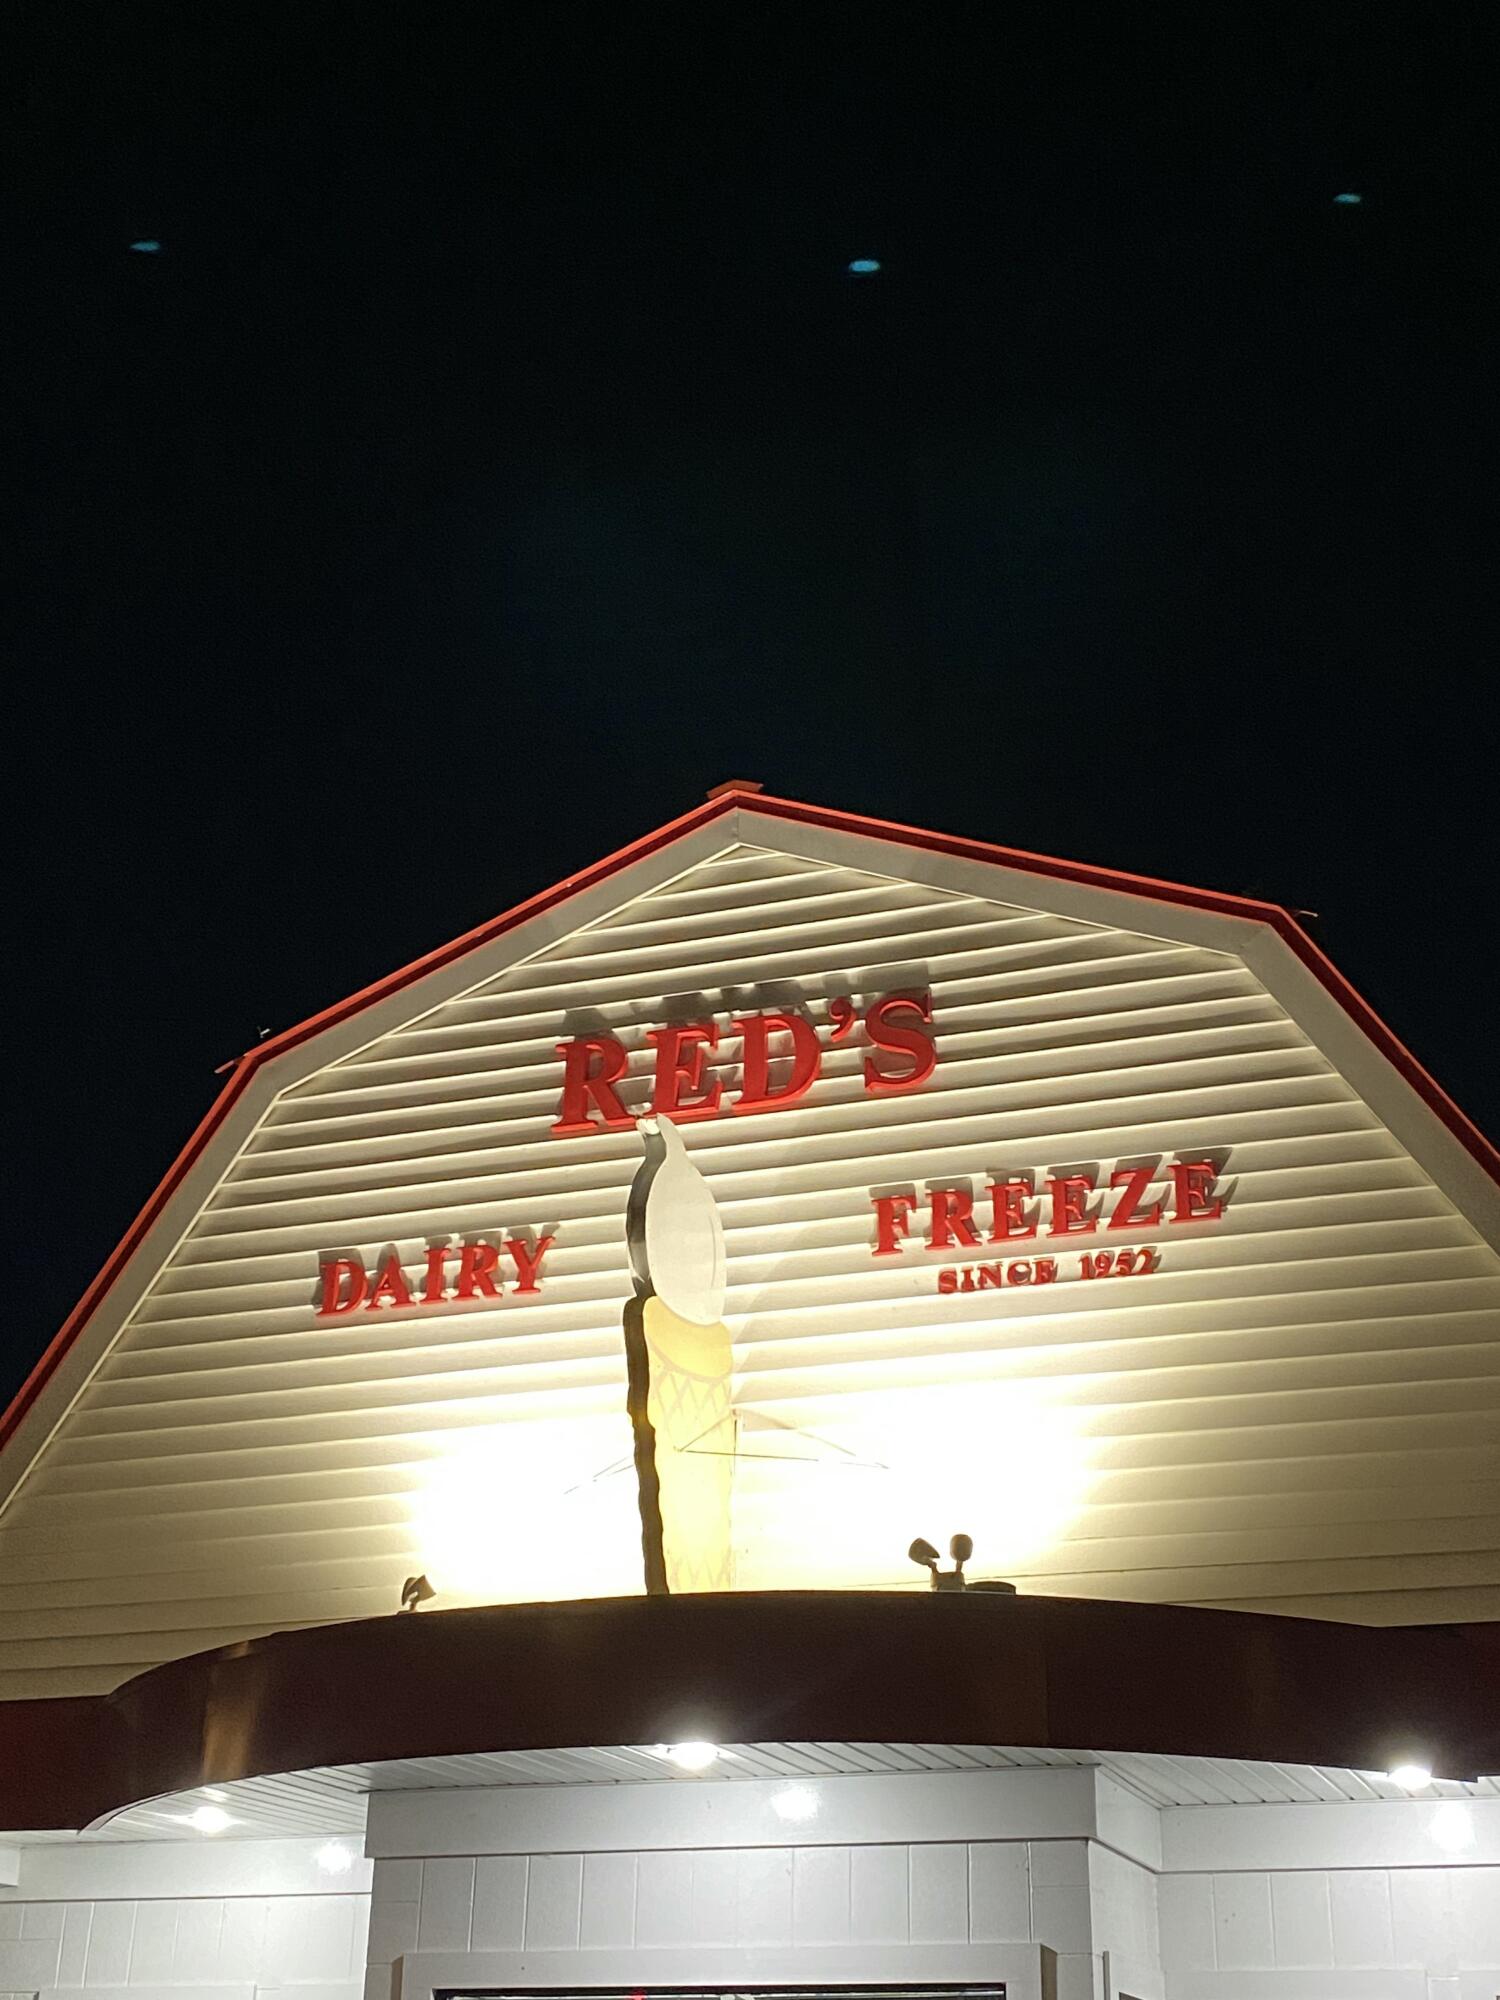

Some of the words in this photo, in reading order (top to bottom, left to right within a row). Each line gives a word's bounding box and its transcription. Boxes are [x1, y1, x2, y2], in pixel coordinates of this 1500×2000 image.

[551, 986, 937, 1133] RED'S
[316, 1235, 556, 1317] DAIRY
[871, 1159, 1223, 1257] FREEZE
[938, 1258, 1056, 1294] SINCE
[1079, 1248, 1155, 1281] 1952
